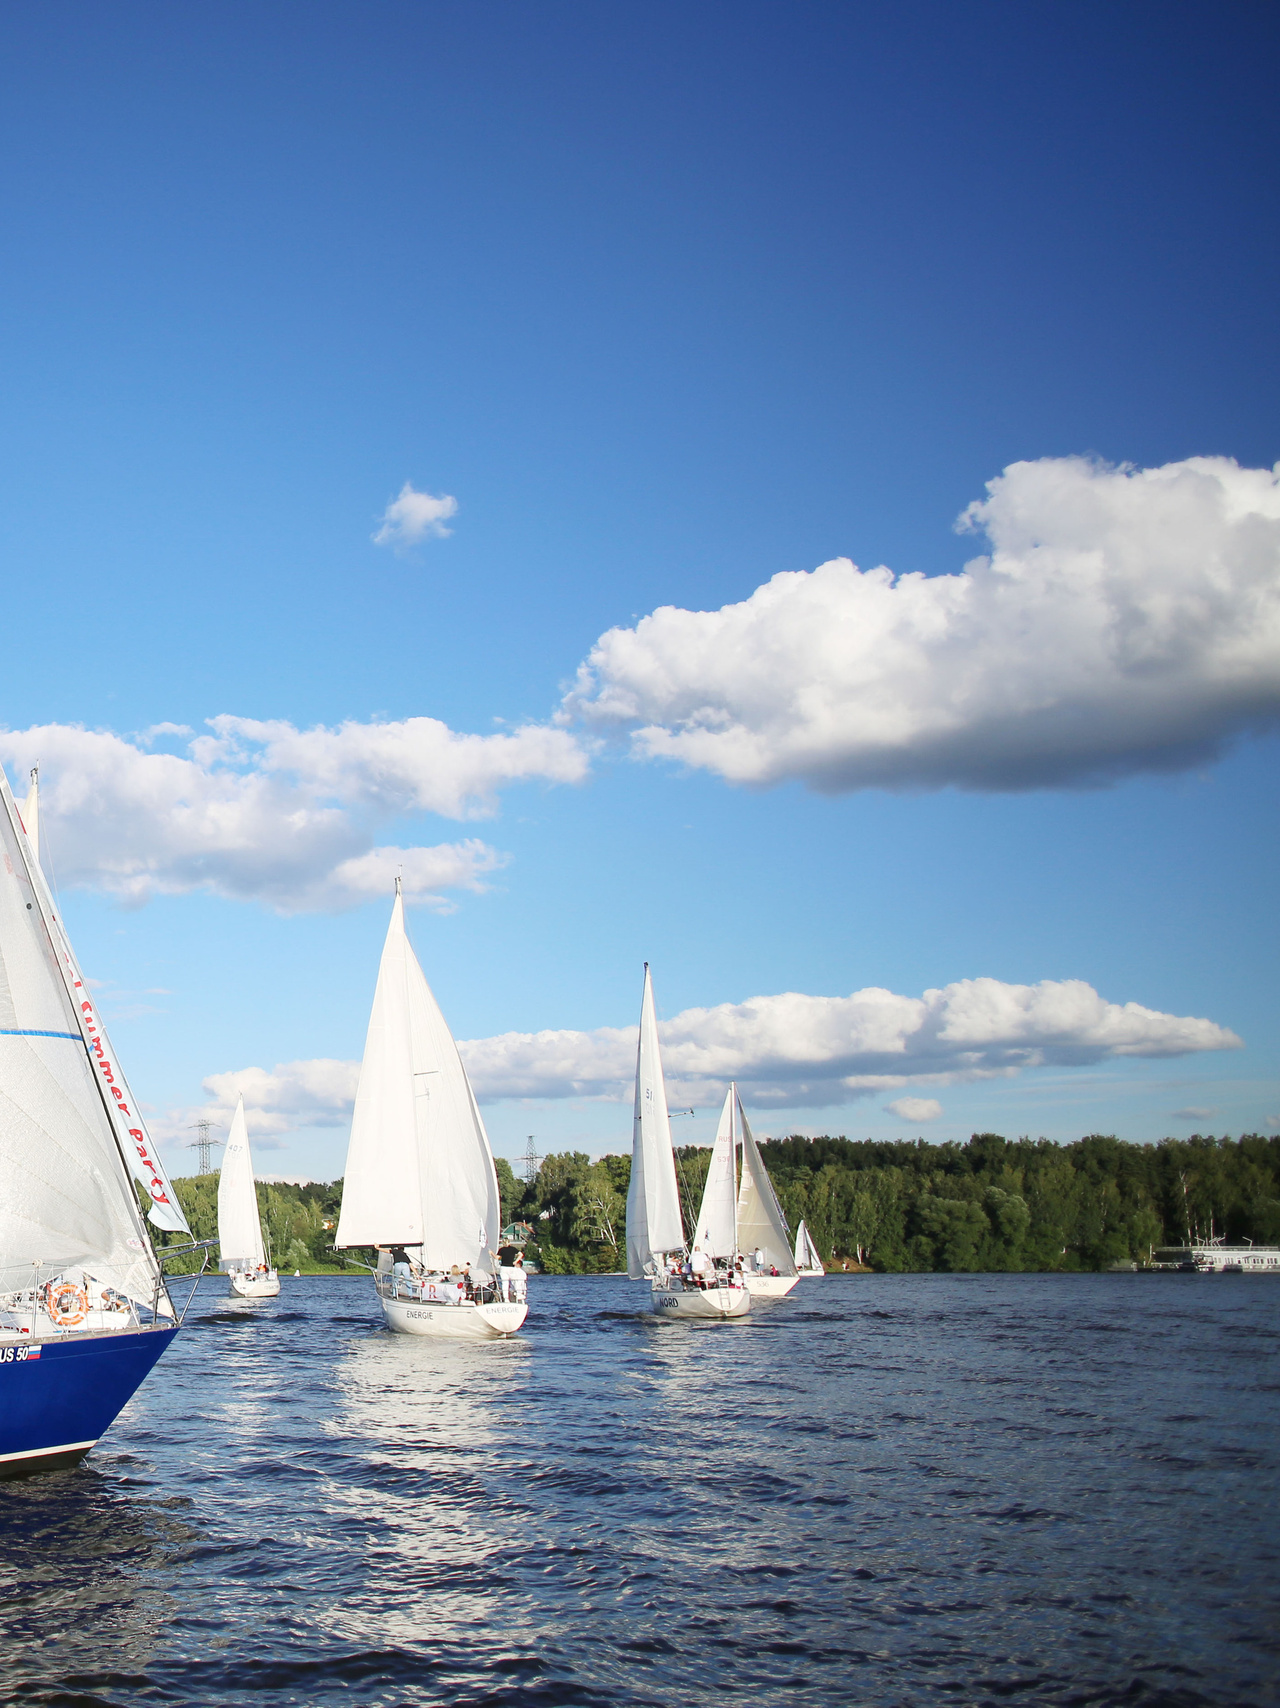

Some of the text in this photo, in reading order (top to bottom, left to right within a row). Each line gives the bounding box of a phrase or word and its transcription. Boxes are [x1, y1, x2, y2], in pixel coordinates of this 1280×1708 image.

[718, 1135, 732, 1143] RUS
[128, 1128, 170, 1204] Party
[756, 1280, 770, 1288] 536
[659, 1297, 679, 1308] NORD
[406, 1310, 434, 1320] ENERGIE
[485, 1306, 520, 1314] ENERGIE
[16, 1346, 29, 1361] 50
